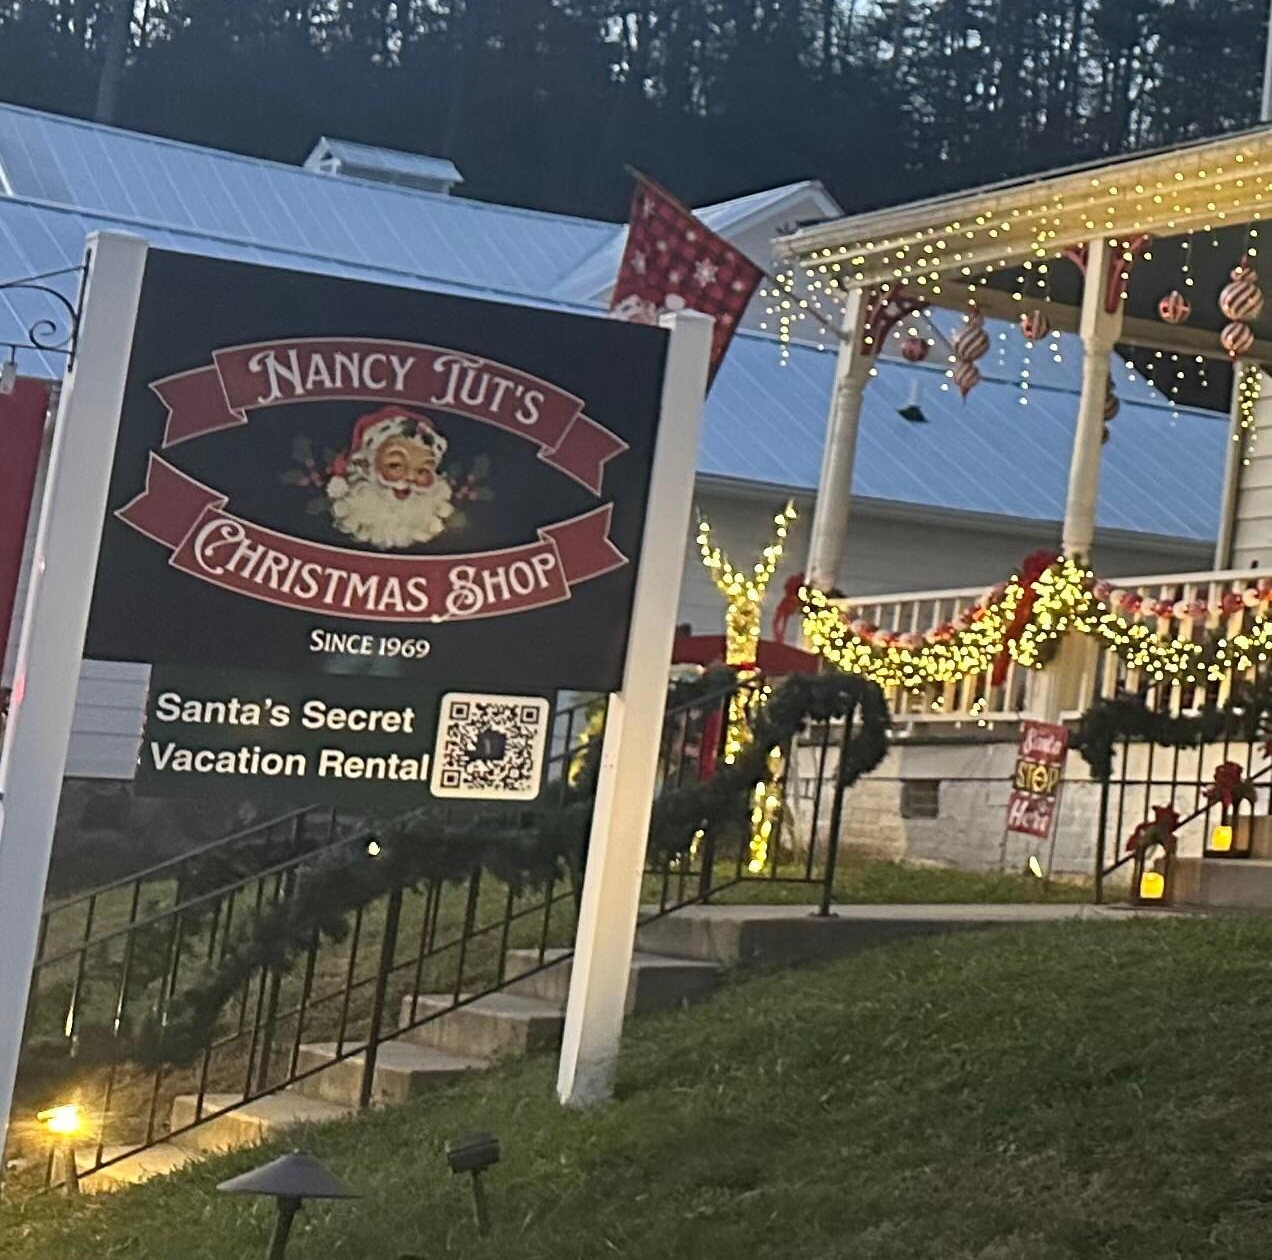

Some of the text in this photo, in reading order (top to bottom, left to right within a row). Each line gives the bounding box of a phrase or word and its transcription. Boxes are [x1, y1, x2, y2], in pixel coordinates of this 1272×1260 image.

[248, 349, 545, 426] NANCY TUT'S
[193, 518, 557, 624] CHRISTMAS SHOP
[309, 628, 431, 660] SINCE 1969
[155, 691, 415, 734] Santa's Secret
[150, 741, 430, 782] Vacation Rental
[1015, 761, 1060, 793] STOP
